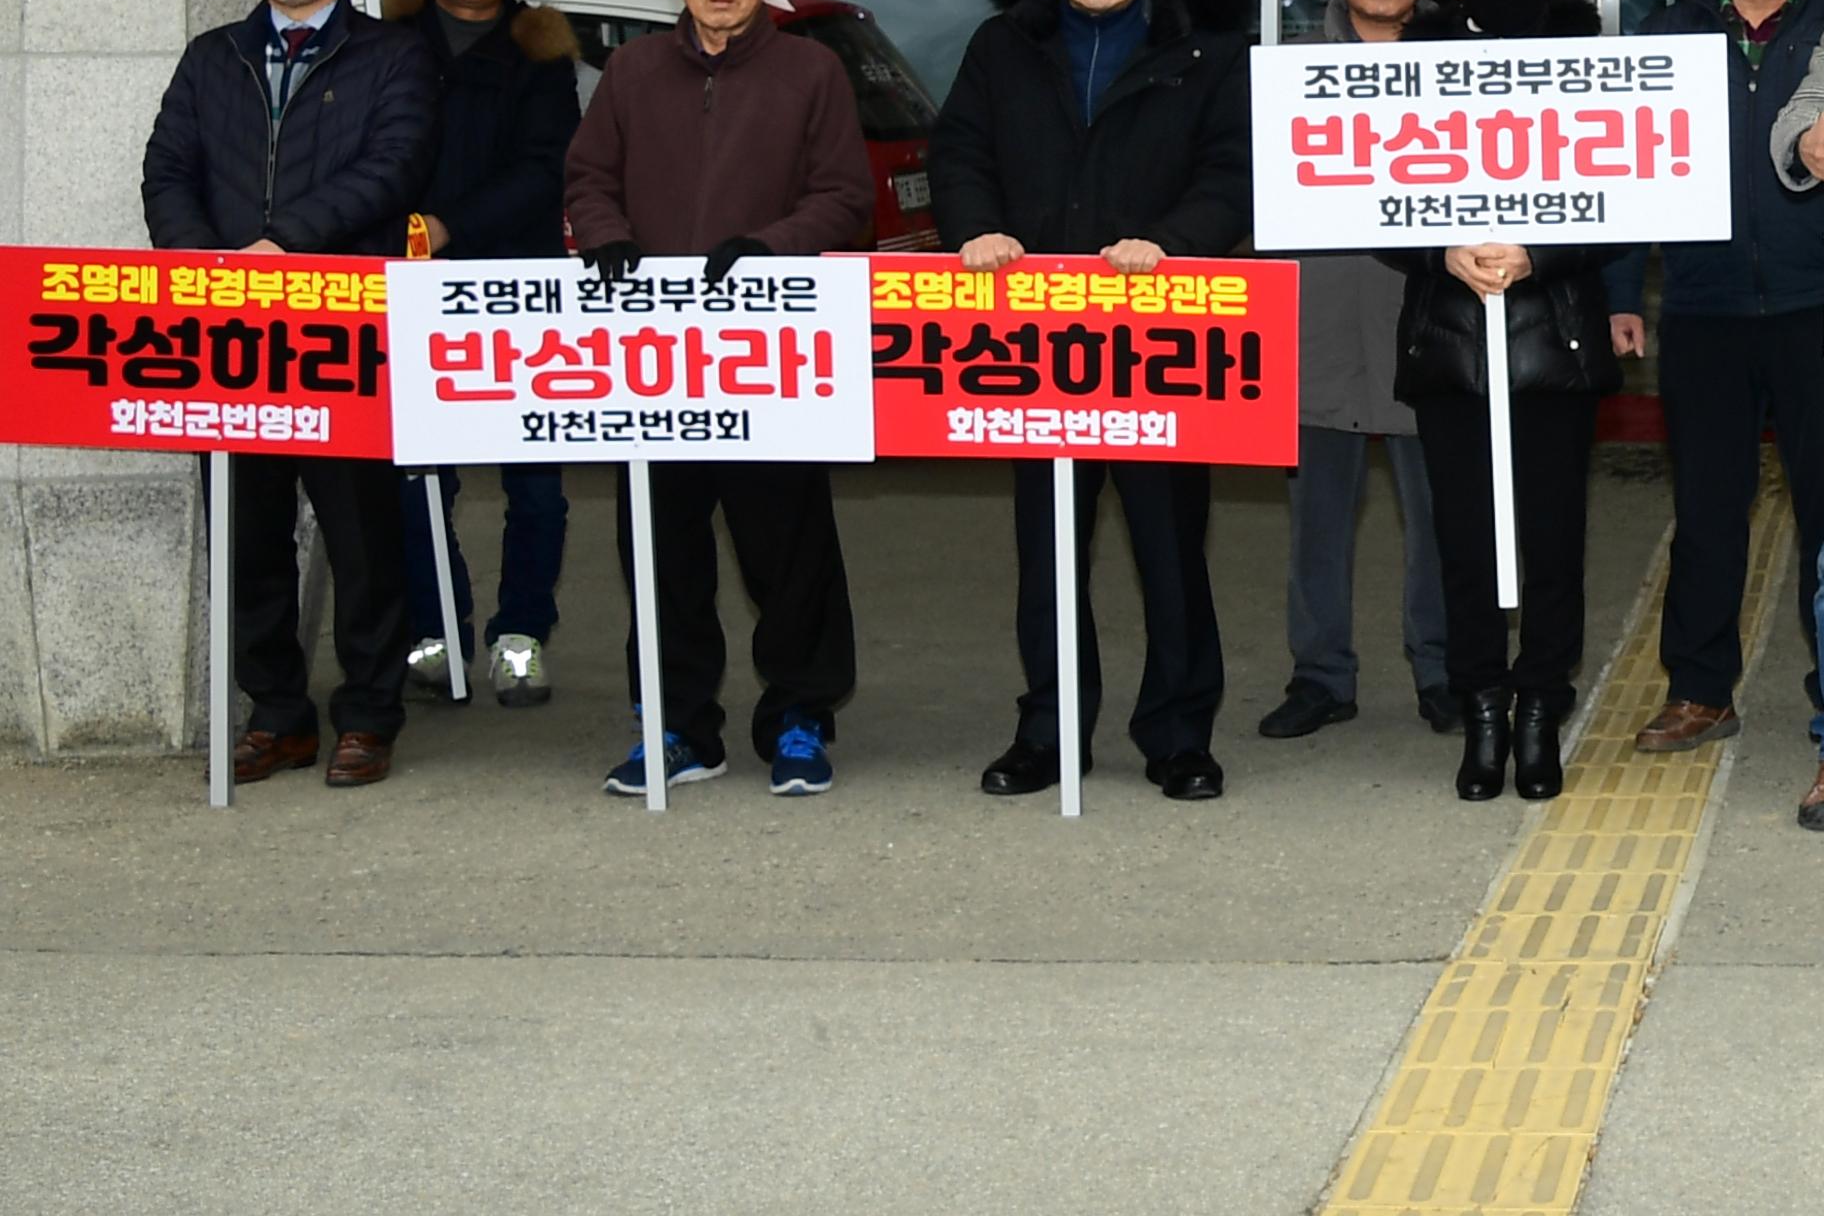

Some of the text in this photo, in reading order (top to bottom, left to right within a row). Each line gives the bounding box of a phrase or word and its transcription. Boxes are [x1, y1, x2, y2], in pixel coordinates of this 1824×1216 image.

[1307, 55, 1675, 98] 조명래 환경부장관은
[1291, 105, 1691, 187] 반성하라!
[1379, 191, 1606, 227] 화천군번영회
[42, 263, 387, 313] 조명래 환경부장관은
[442, 276, 820, 316] 조명래 환경부장관은
[872, 271, 1249, 316] 조명래 환경부장관은
[428, 325, 835, 403] 반성하라!
[871, 322, 1260, 400] 각성하라!
[111, 399, 329, 442] 화천군번영회
[522, 410, 749, 442] 화천군번영회
[947, 407, 1177, 447] 화천군번영회
